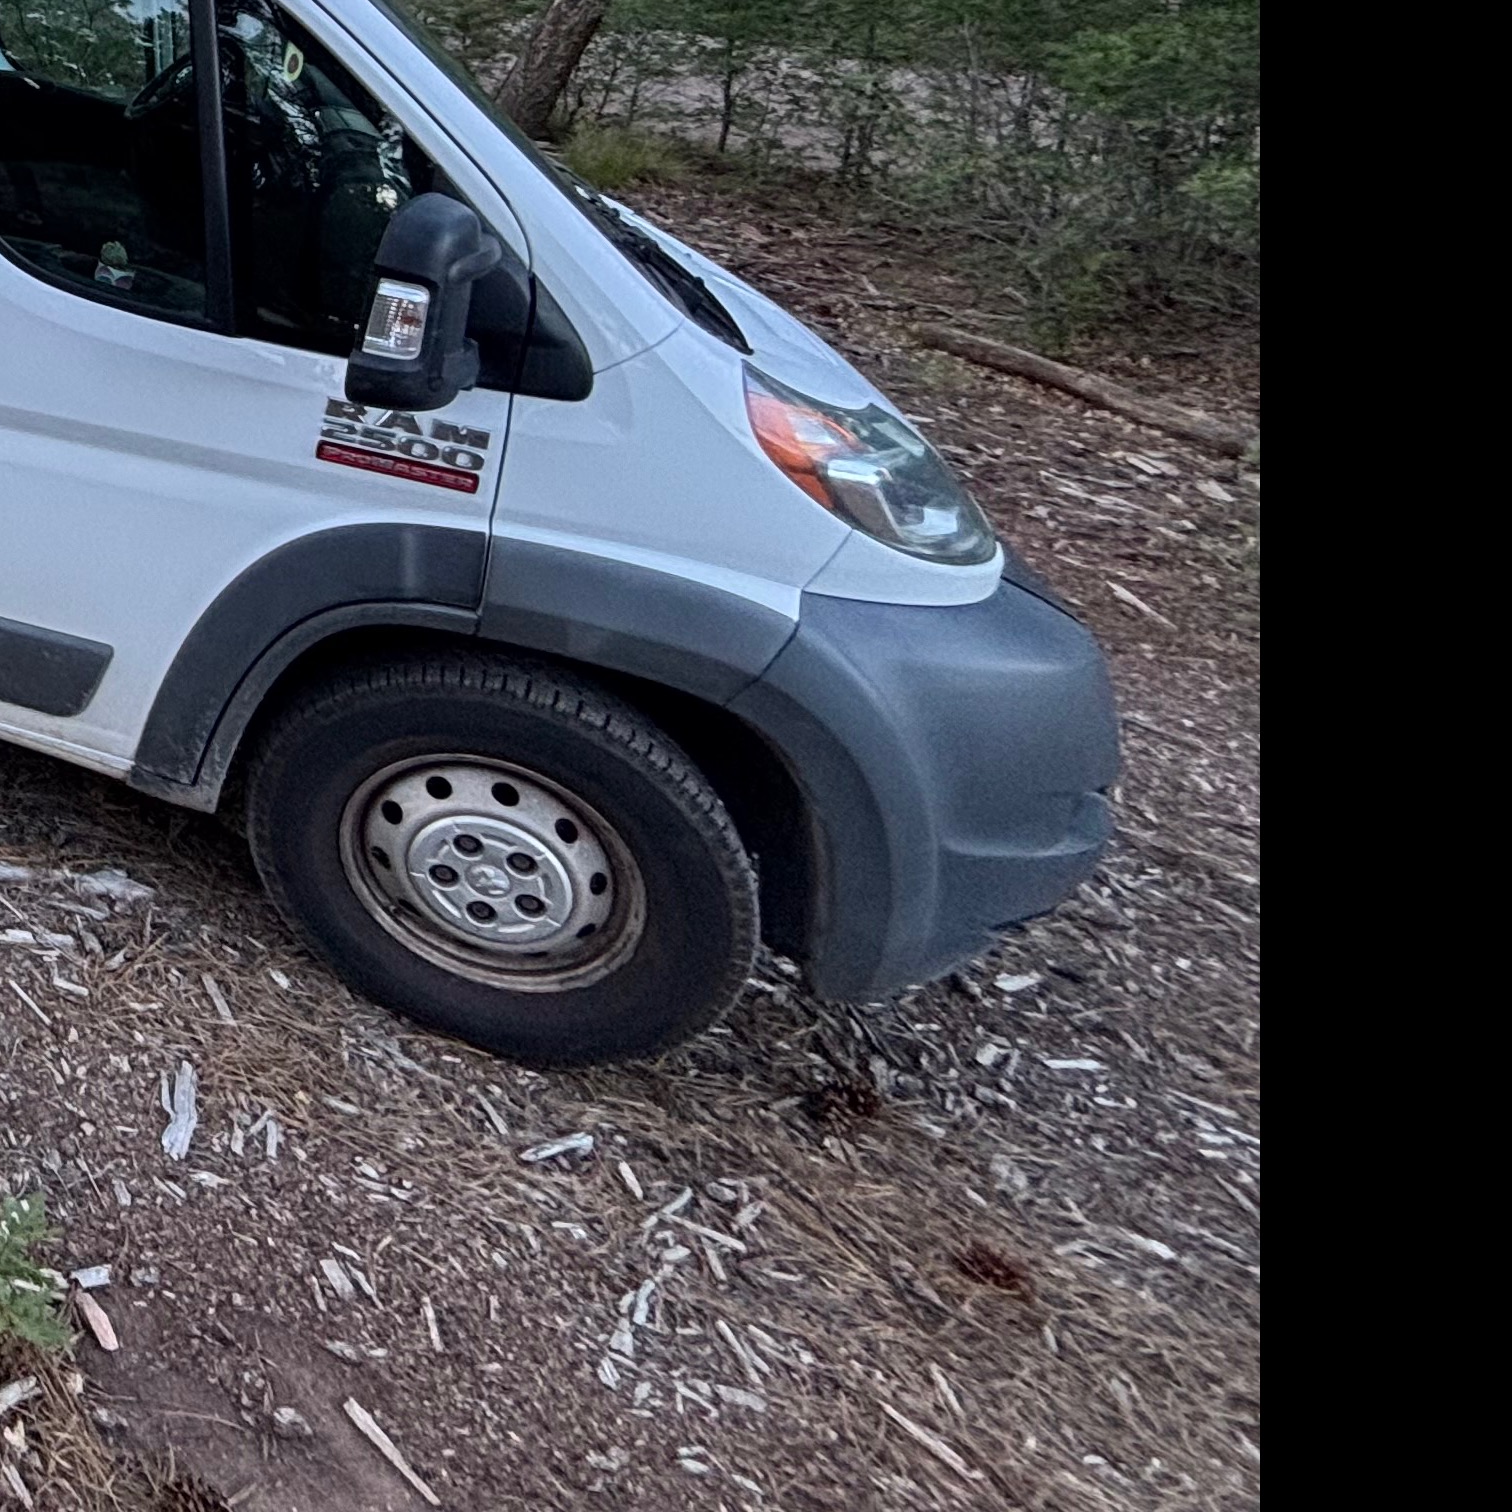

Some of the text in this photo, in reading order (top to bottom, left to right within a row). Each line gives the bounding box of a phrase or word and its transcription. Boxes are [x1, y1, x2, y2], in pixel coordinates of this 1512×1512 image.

[319, 416, 486, 471] 2500
[324, 396, 492, 450] RAM
[321, 445, 475, 489] PROMASTER
